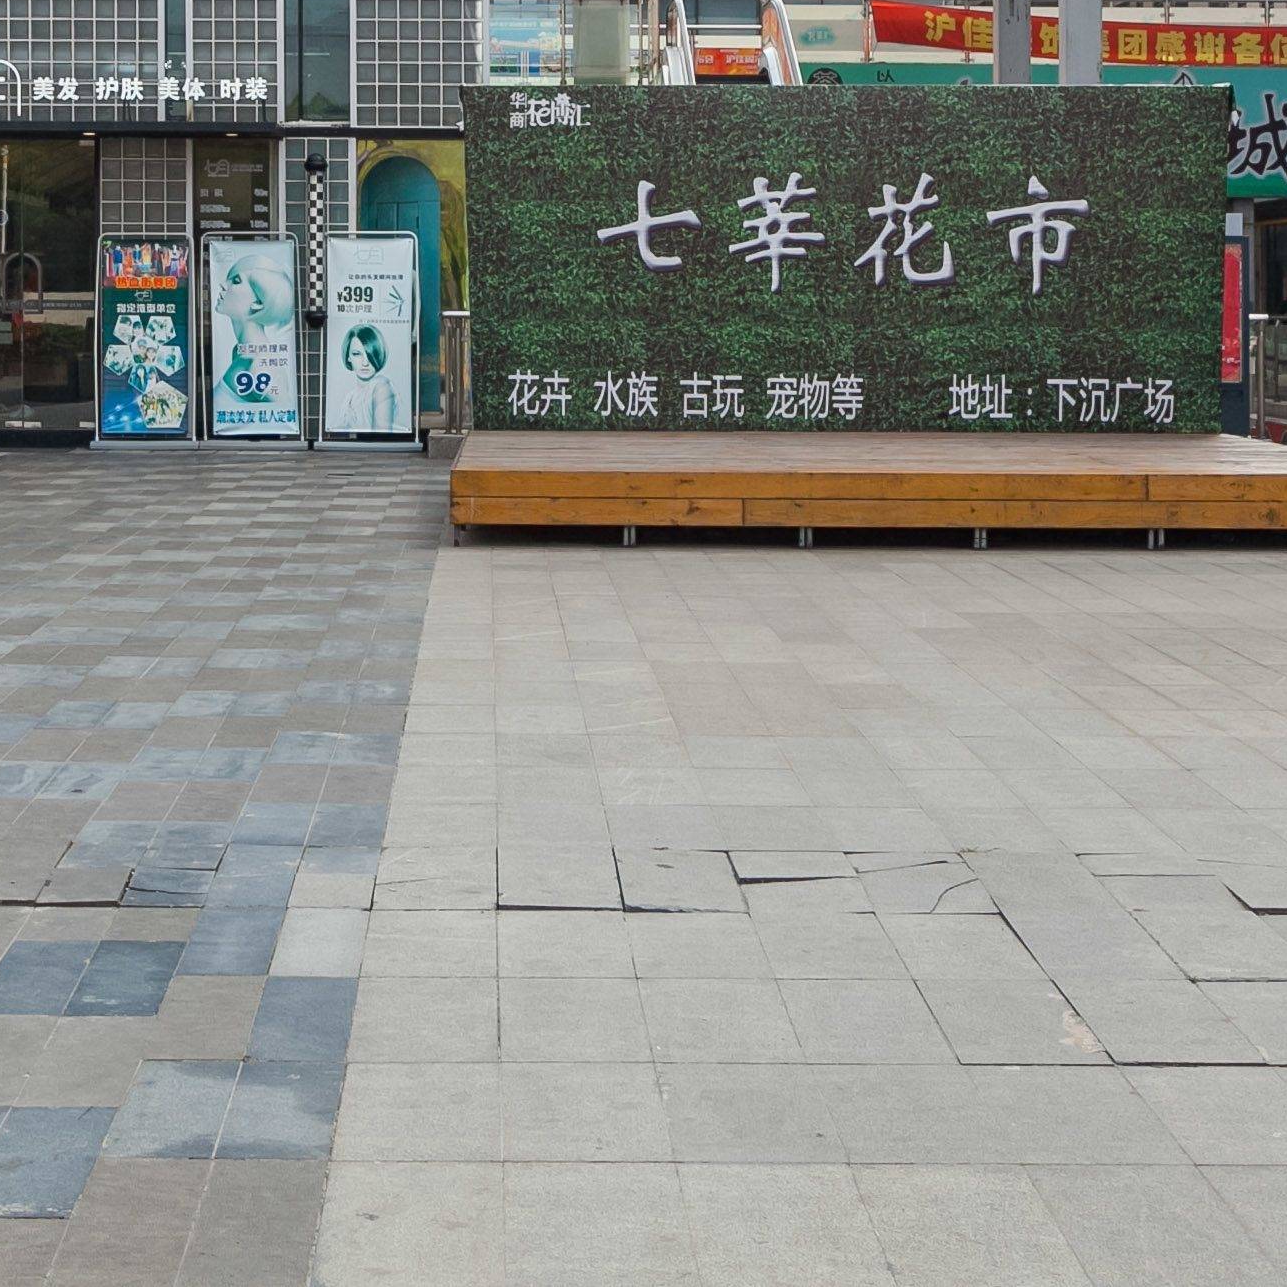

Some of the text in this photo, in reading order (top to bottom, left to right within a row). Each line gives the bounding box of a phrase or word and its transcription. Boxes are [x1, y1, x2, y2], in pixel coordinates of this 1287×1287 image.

[33, 77, 268, 101] 美发 护肤 美体 时装
[596, 172, 1090, 295] 七莘花市
[507, 369, 573, 416] 花卉
[593, 370, 659, 416] 水族
[679, 371, 744, 419] 古玩
[766, 373, 864, 420] 宠物等
